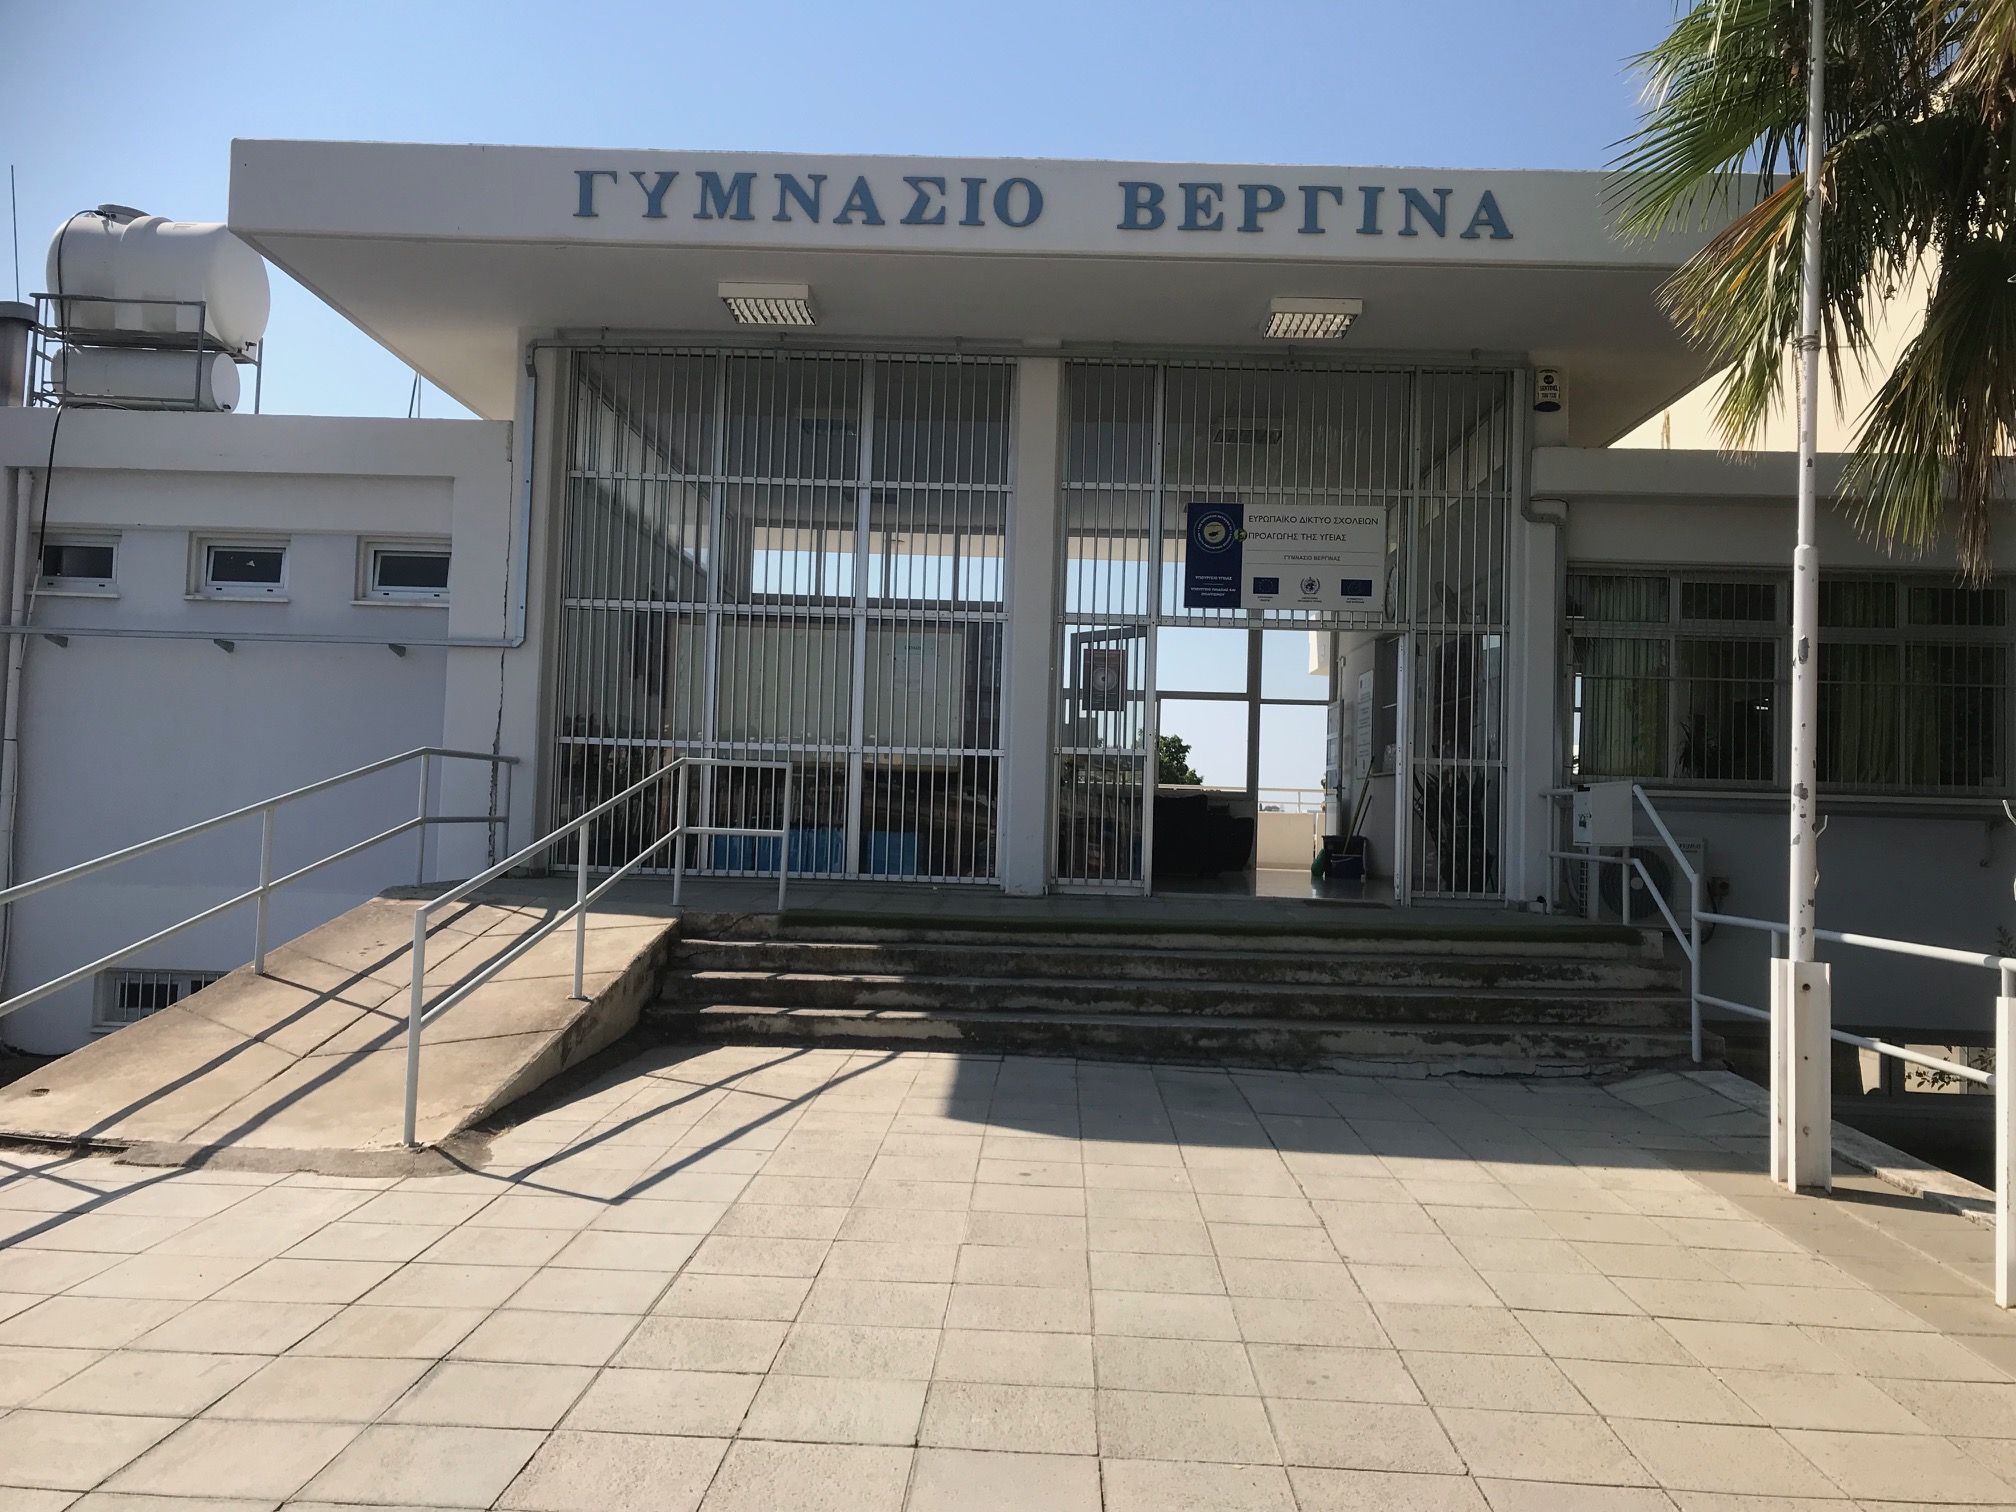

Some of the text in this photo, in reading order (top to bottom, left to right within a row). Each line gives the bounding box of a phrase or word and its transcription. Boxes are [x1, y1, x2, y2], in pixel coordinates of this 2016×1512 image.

[573, 169, 1514, 240] ΓΥΜΝΑΣΙΟ ΒΕΡΓΙΝΑ
[1299, 516, 1331, 525] ΔΙΚΤΥΟ
[1333, 517, 1379, 525] ΣΧΟΛΕΙΩΝ
[1248, 532, 1347, 542] ΠΡΟΑΓΩΓΗΣ ΤΗΣ ΥΓΕΙΑΣ
